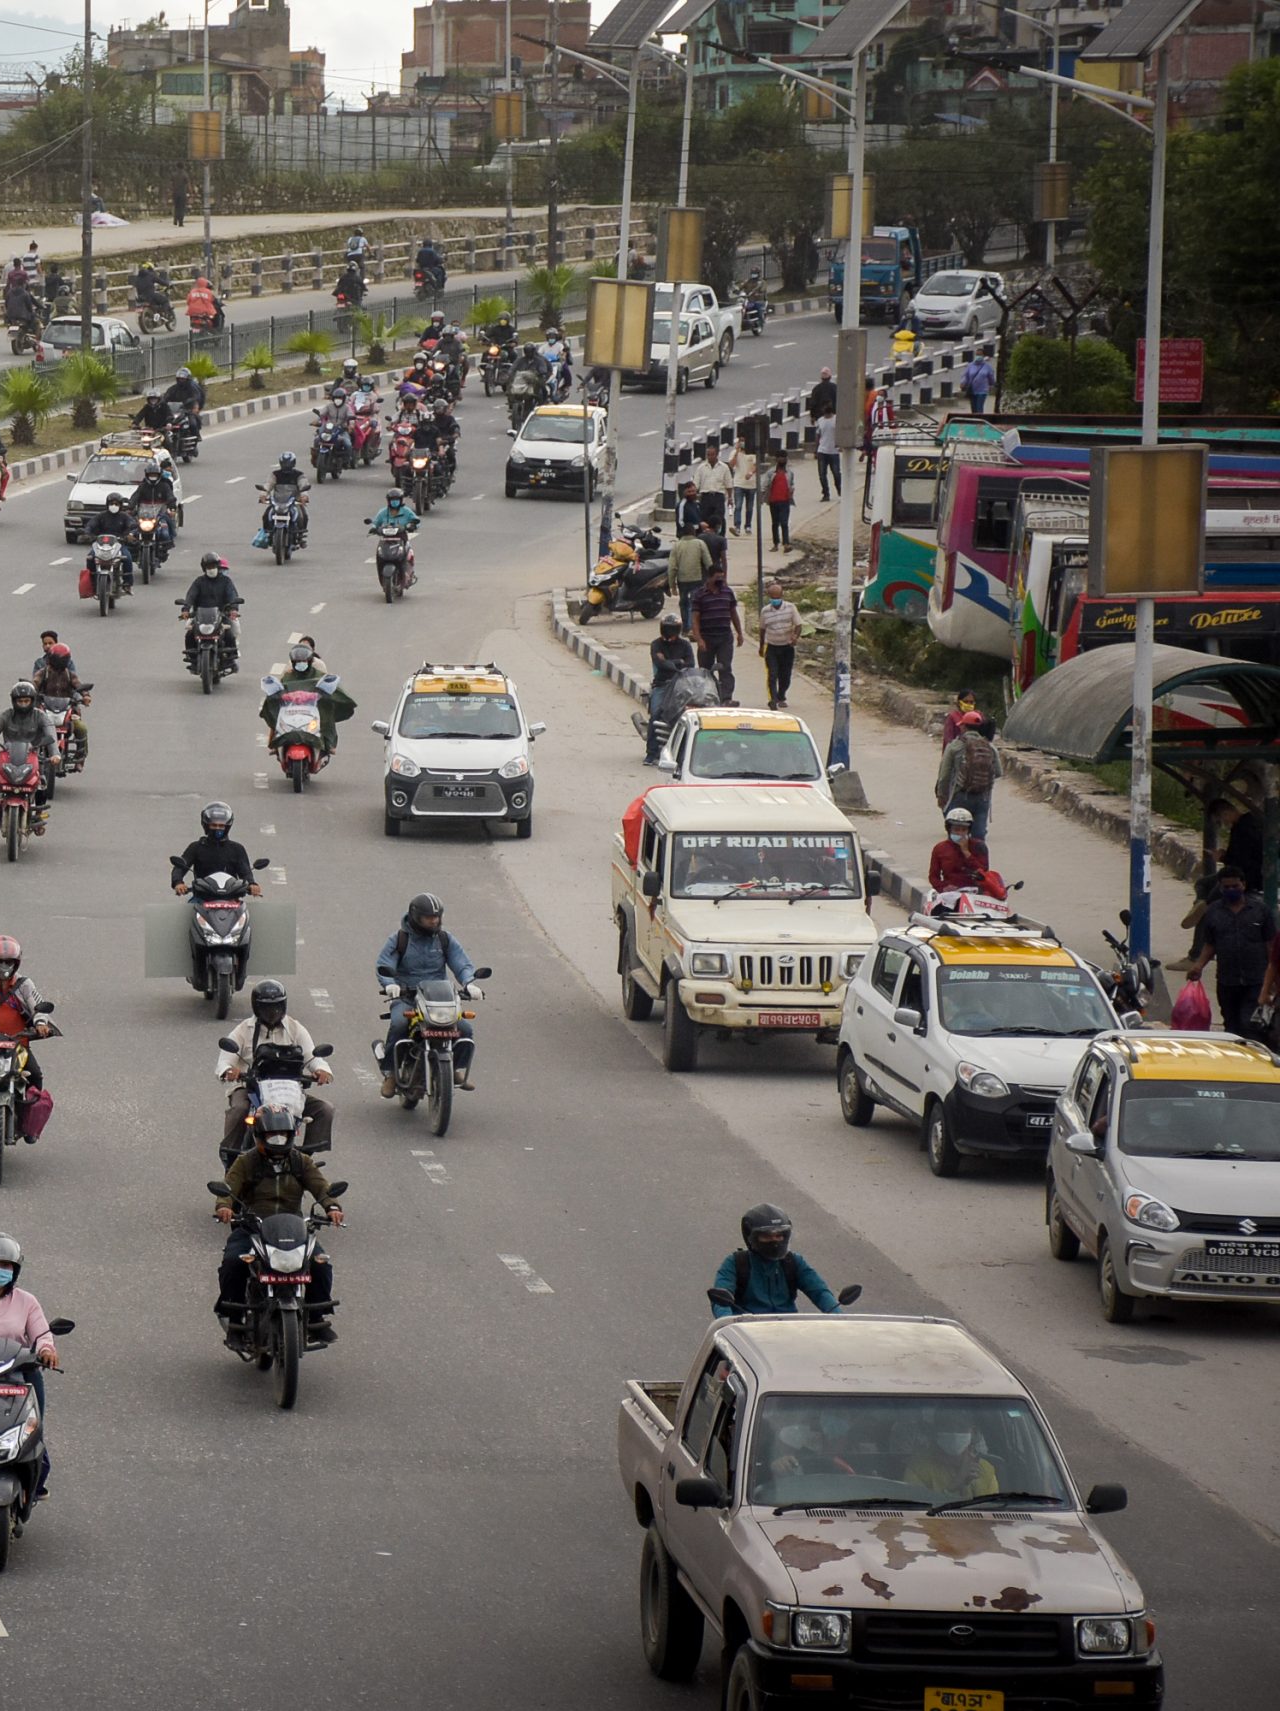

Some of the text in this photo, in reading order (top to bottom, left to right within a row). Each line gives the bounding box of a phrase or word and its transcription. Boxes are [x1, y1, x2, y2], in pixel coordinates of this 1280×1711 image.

[1189, 606, 1263, 629] Deluxe
[682, 836, 845, 848] OFF ROAD KING
[949, 970, 990, 980] Dolakha
[1040, 971, 1081, 982] Darshan
[1197, 1090, 1225, 1098] TAXI
[1181, 1273, 1256, 1285] ALTO
